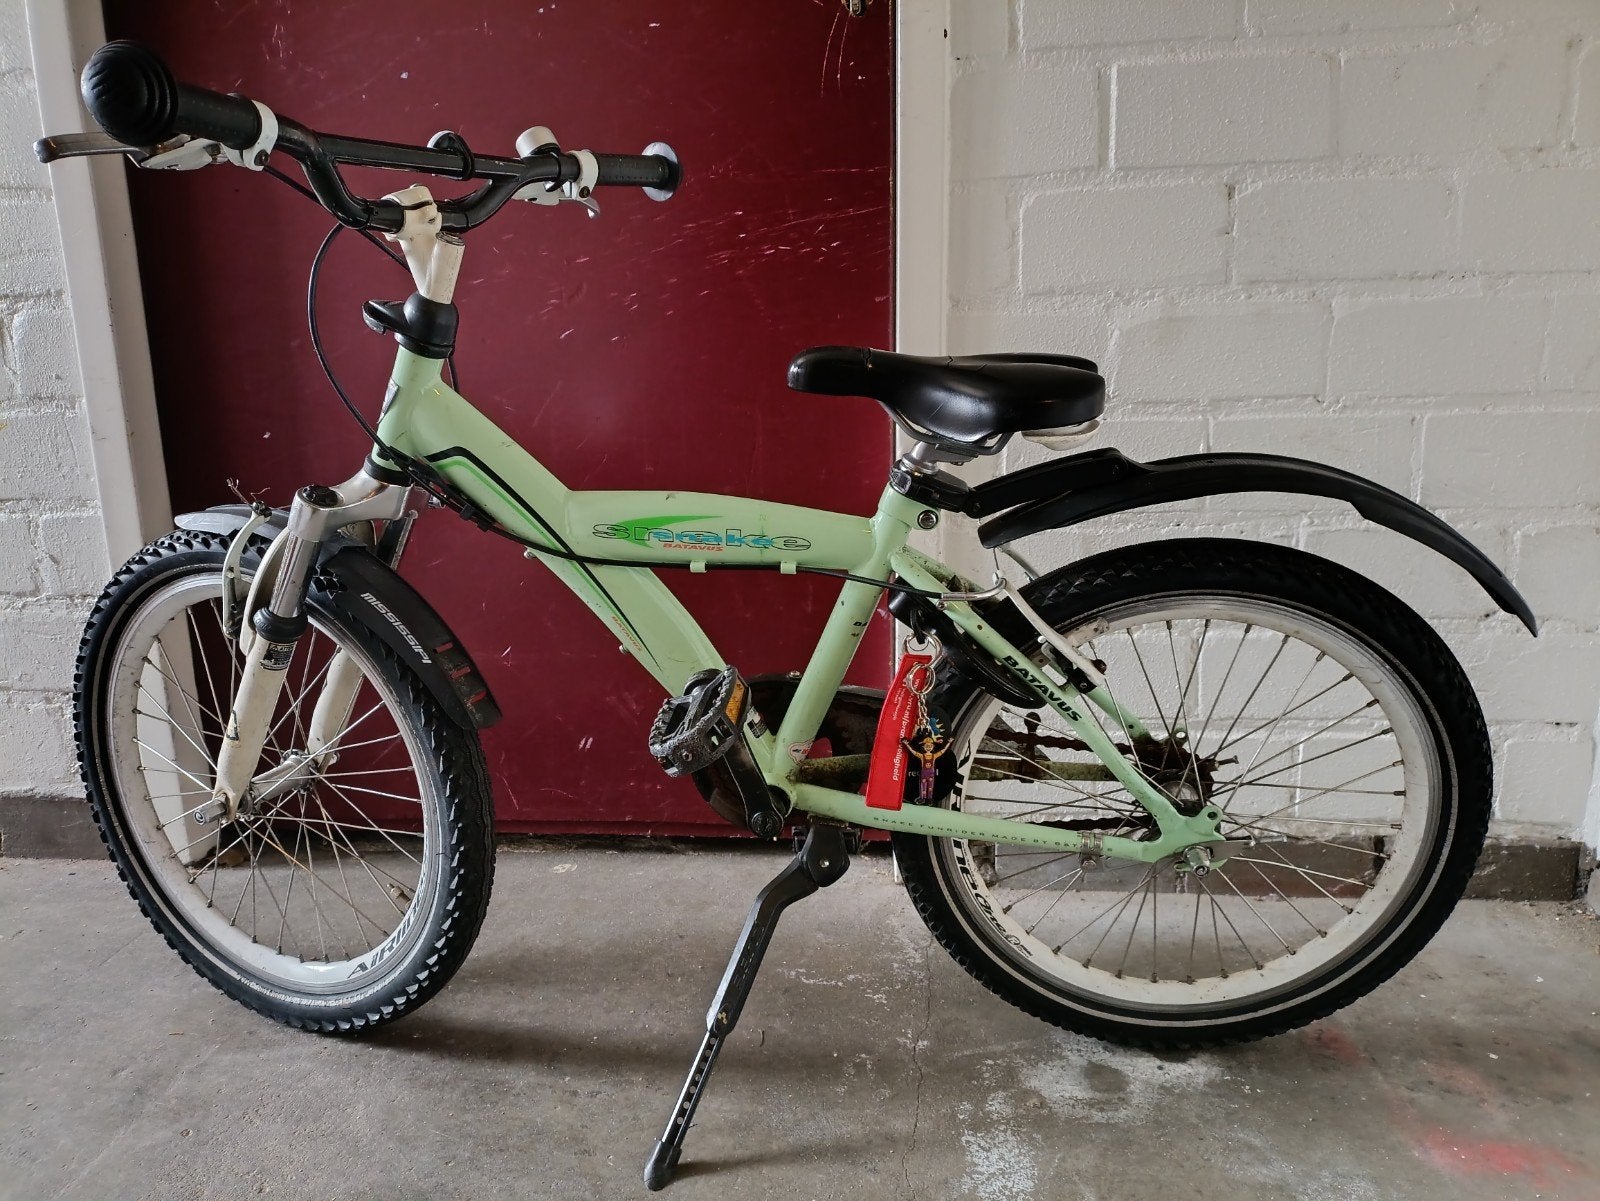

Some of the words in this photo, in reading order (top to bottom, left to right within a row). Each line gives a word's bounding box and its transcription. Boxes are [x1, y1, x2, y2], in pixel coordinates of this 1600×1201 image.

[662, 542, 724, 552] BATAVUS
[1003, 655, 1083, 722] BATAVUS
[992, 833, 1026, 842] MADE
